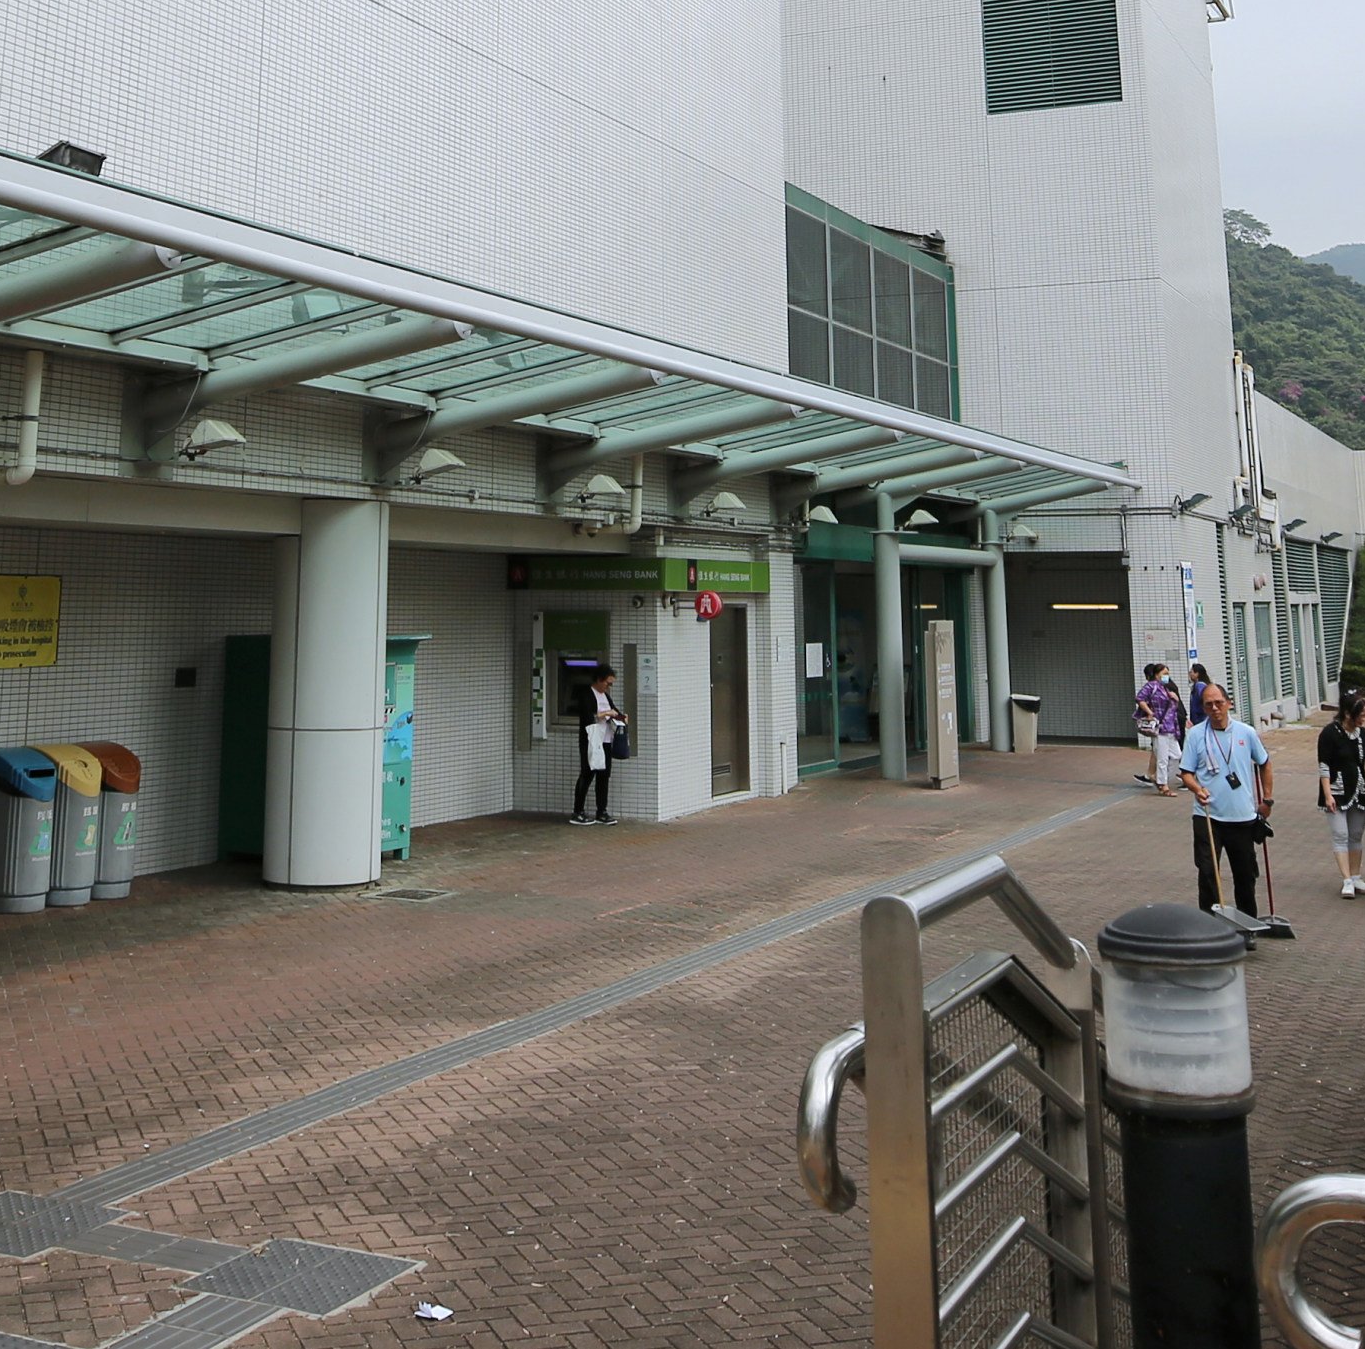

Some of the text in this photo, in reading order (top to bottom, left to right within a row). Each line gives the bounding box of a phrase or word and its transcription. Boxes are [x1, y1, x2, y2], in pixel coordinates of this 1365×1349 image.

[583, 570, 659, 580] HANG SENG BANK
[20, 636, 30, 644] the
[2, 649, 37, 660] prosecution
